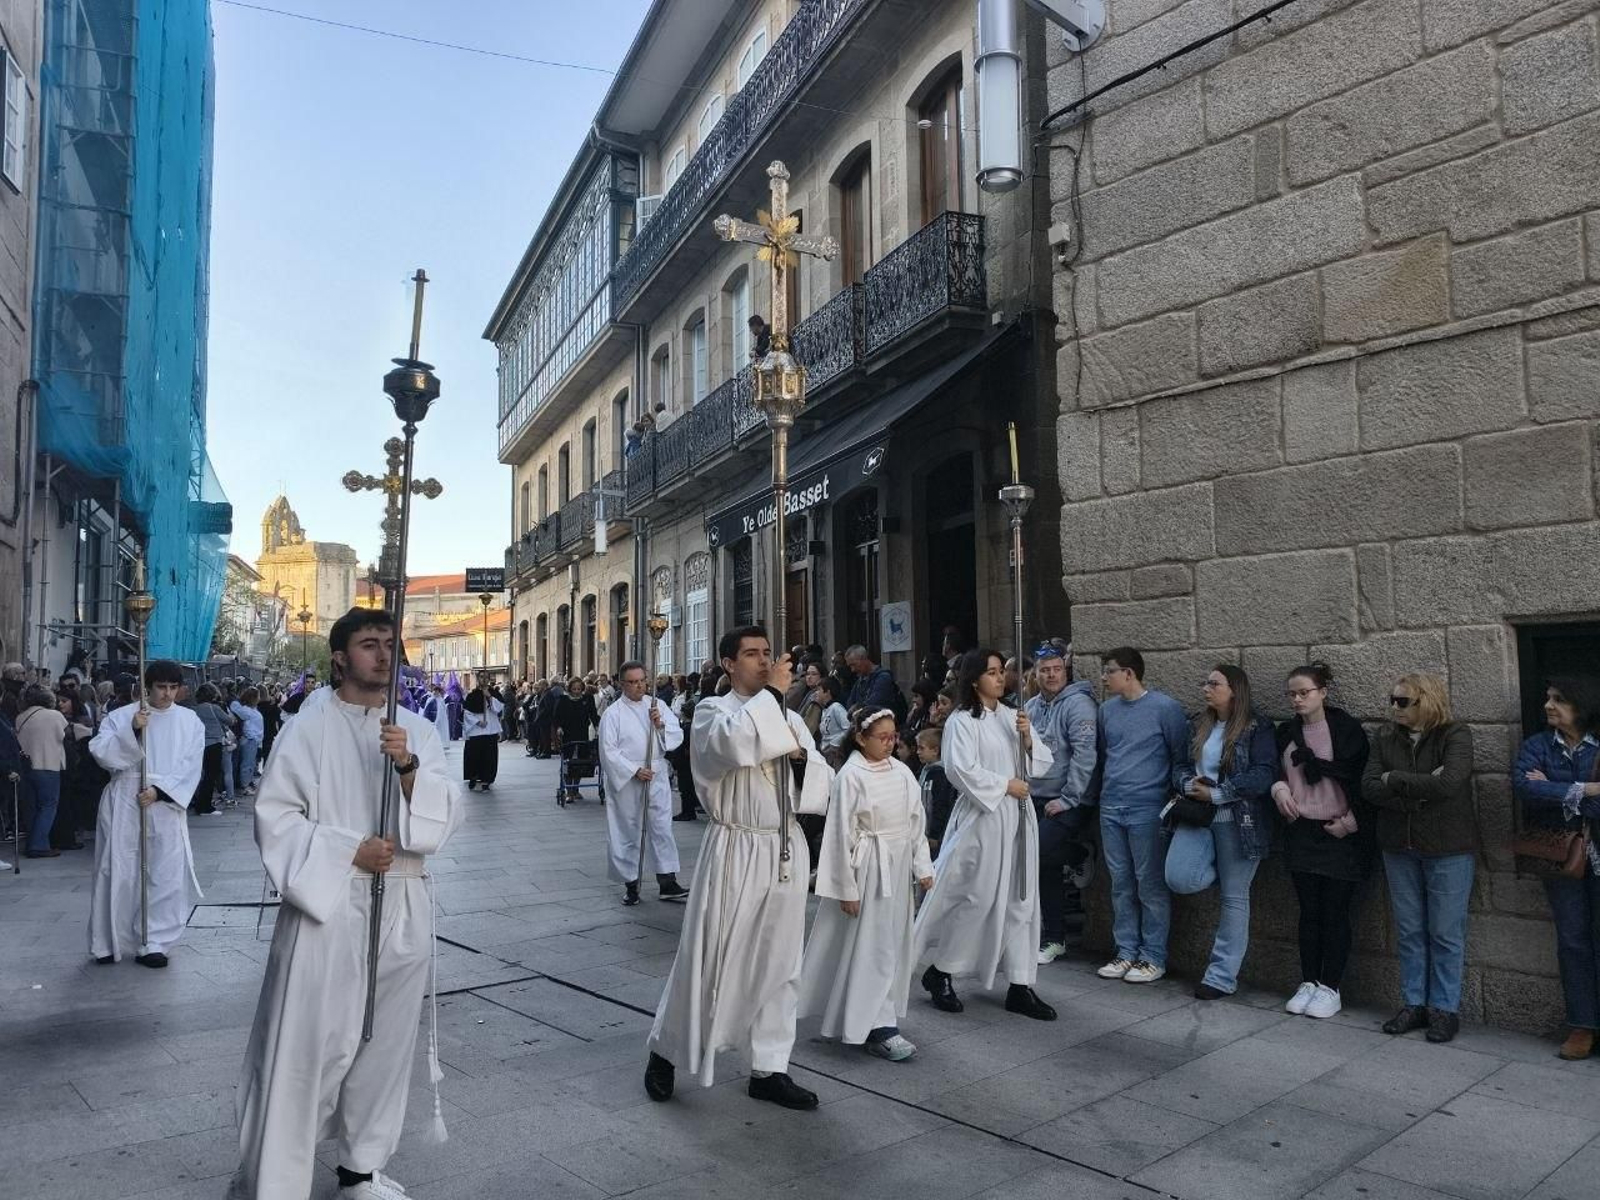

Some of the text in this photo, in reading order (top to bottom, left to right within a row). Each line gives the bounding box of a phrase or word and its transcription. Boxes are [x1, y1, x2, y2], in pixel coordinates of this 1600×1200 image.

[743, 474, 829, 534] Ye Olde Basset
